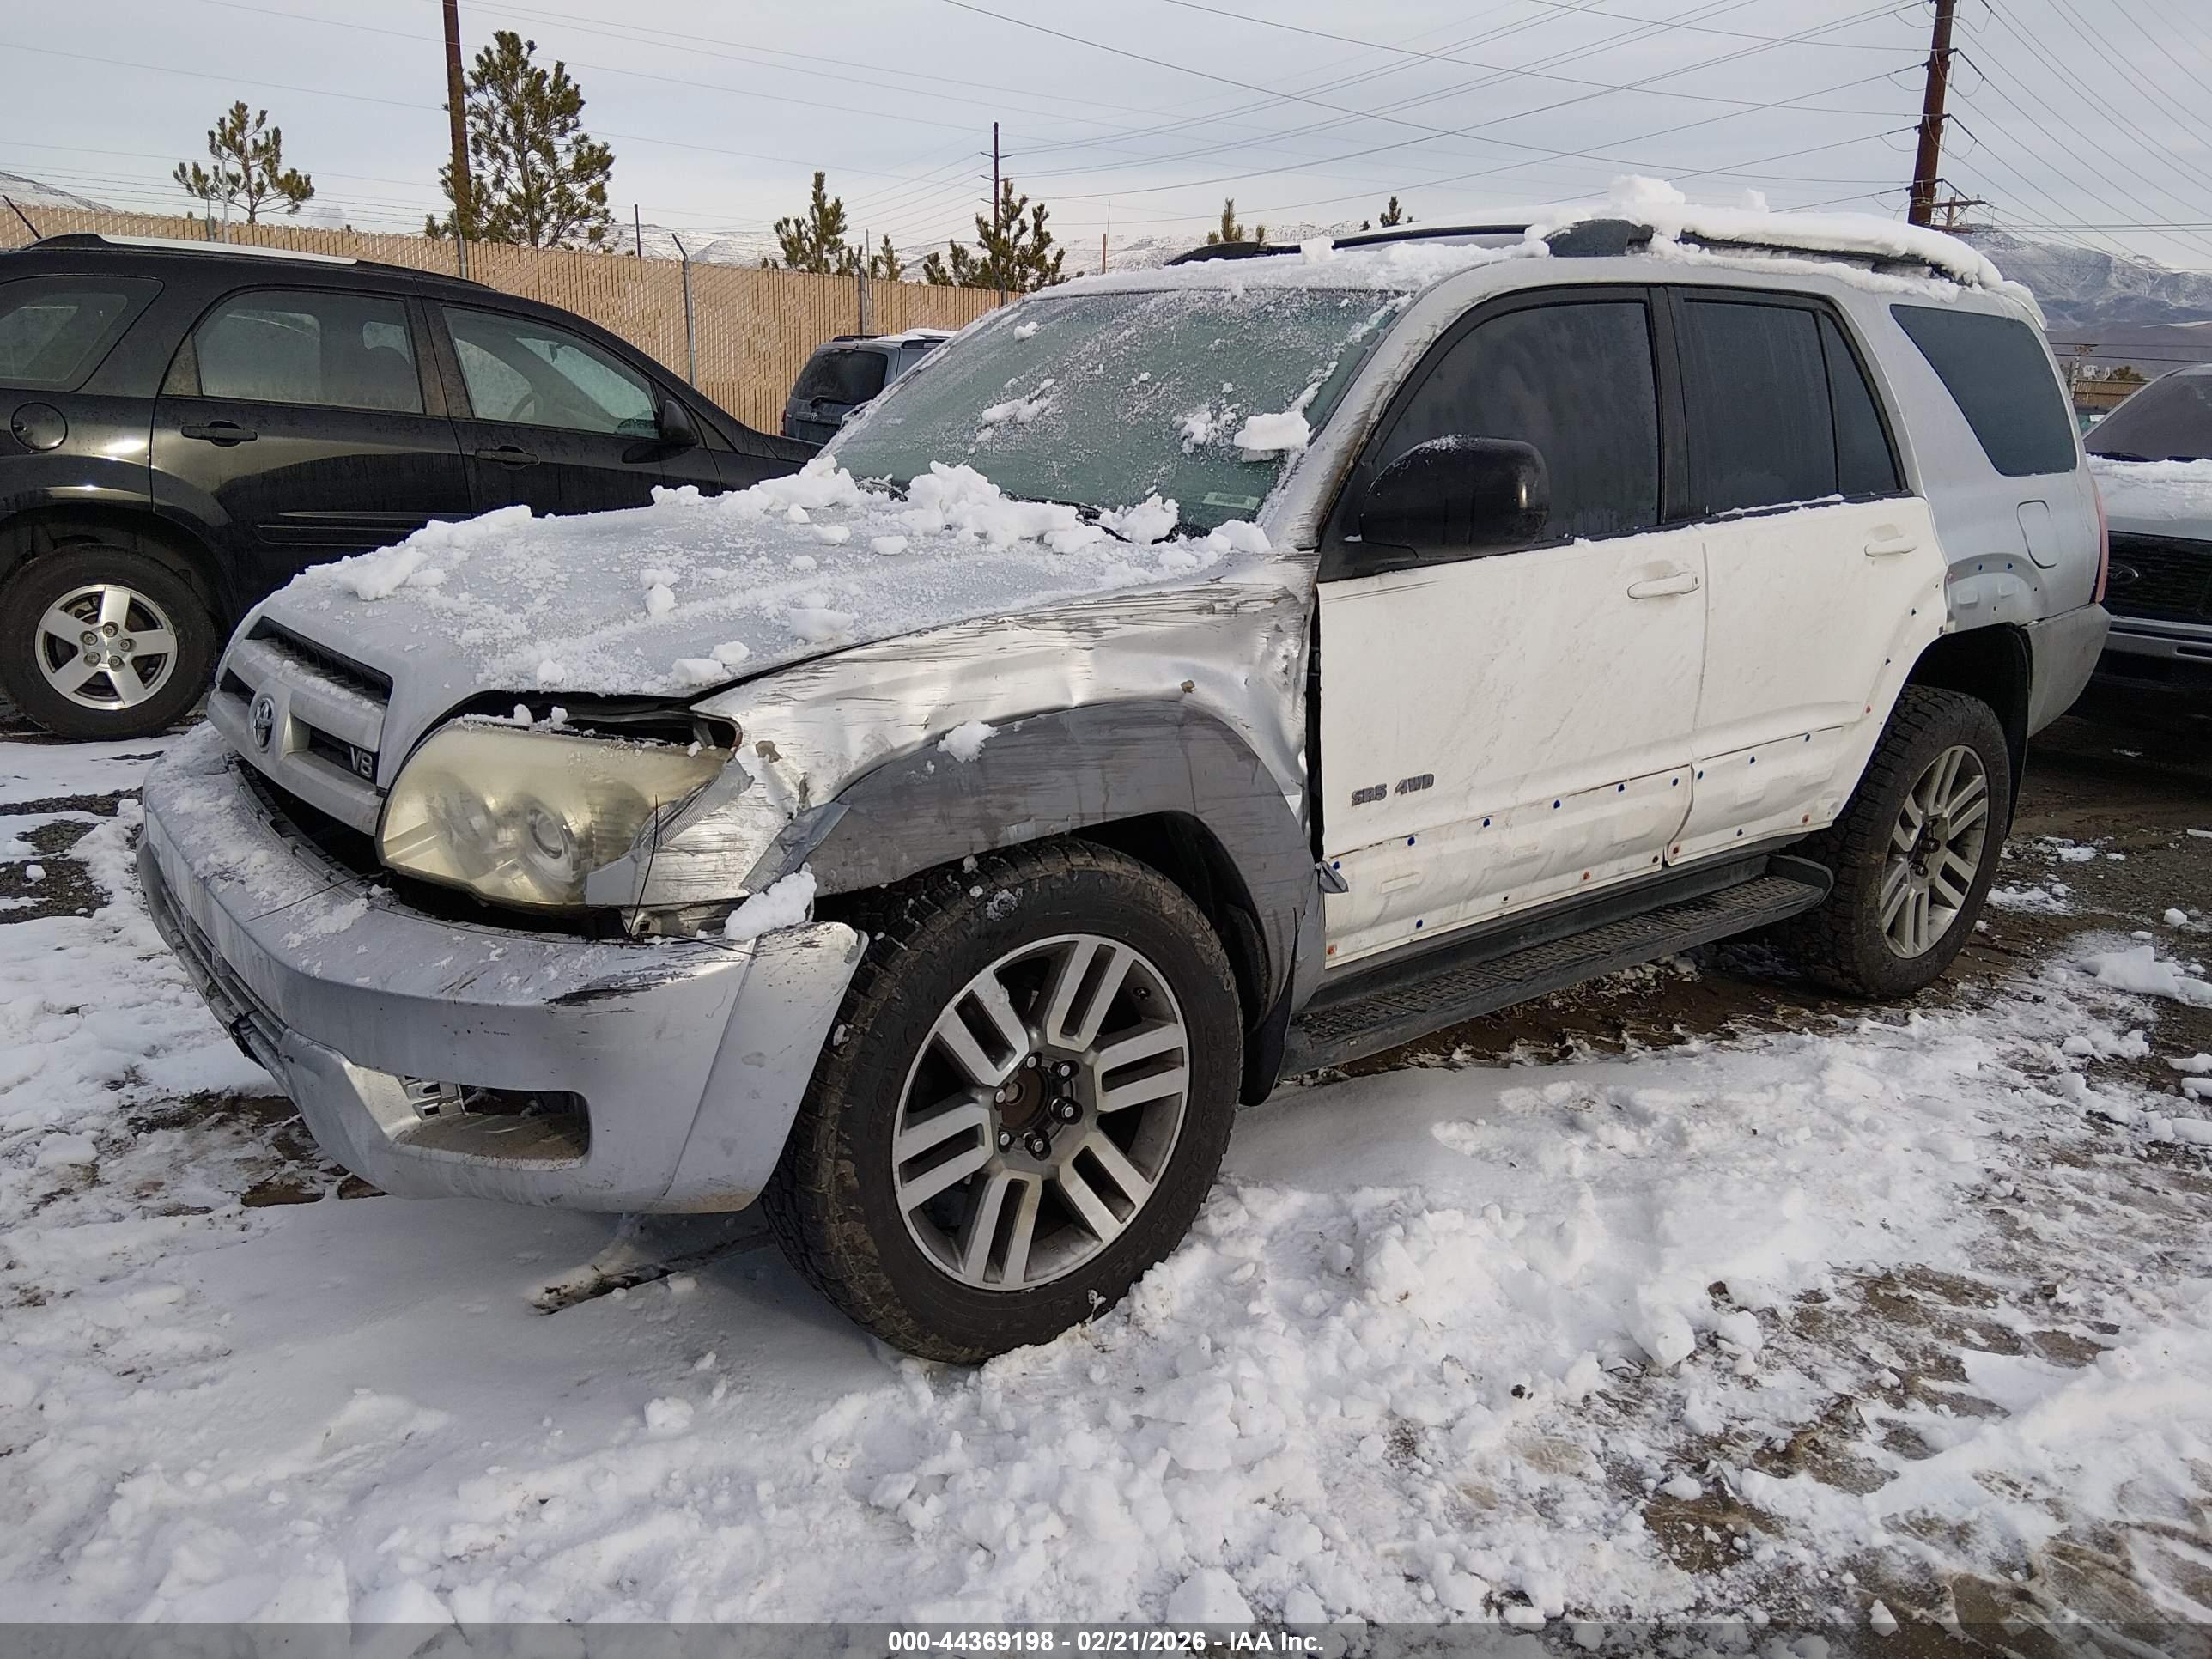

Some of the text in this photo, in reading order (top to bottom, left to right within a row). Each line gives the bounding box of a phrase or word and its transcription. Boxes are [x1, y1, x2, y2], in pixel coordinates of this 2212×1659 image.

[349, 746, 373, 779] V8
[1352, 773, 1435, 807] SR5 4WD
